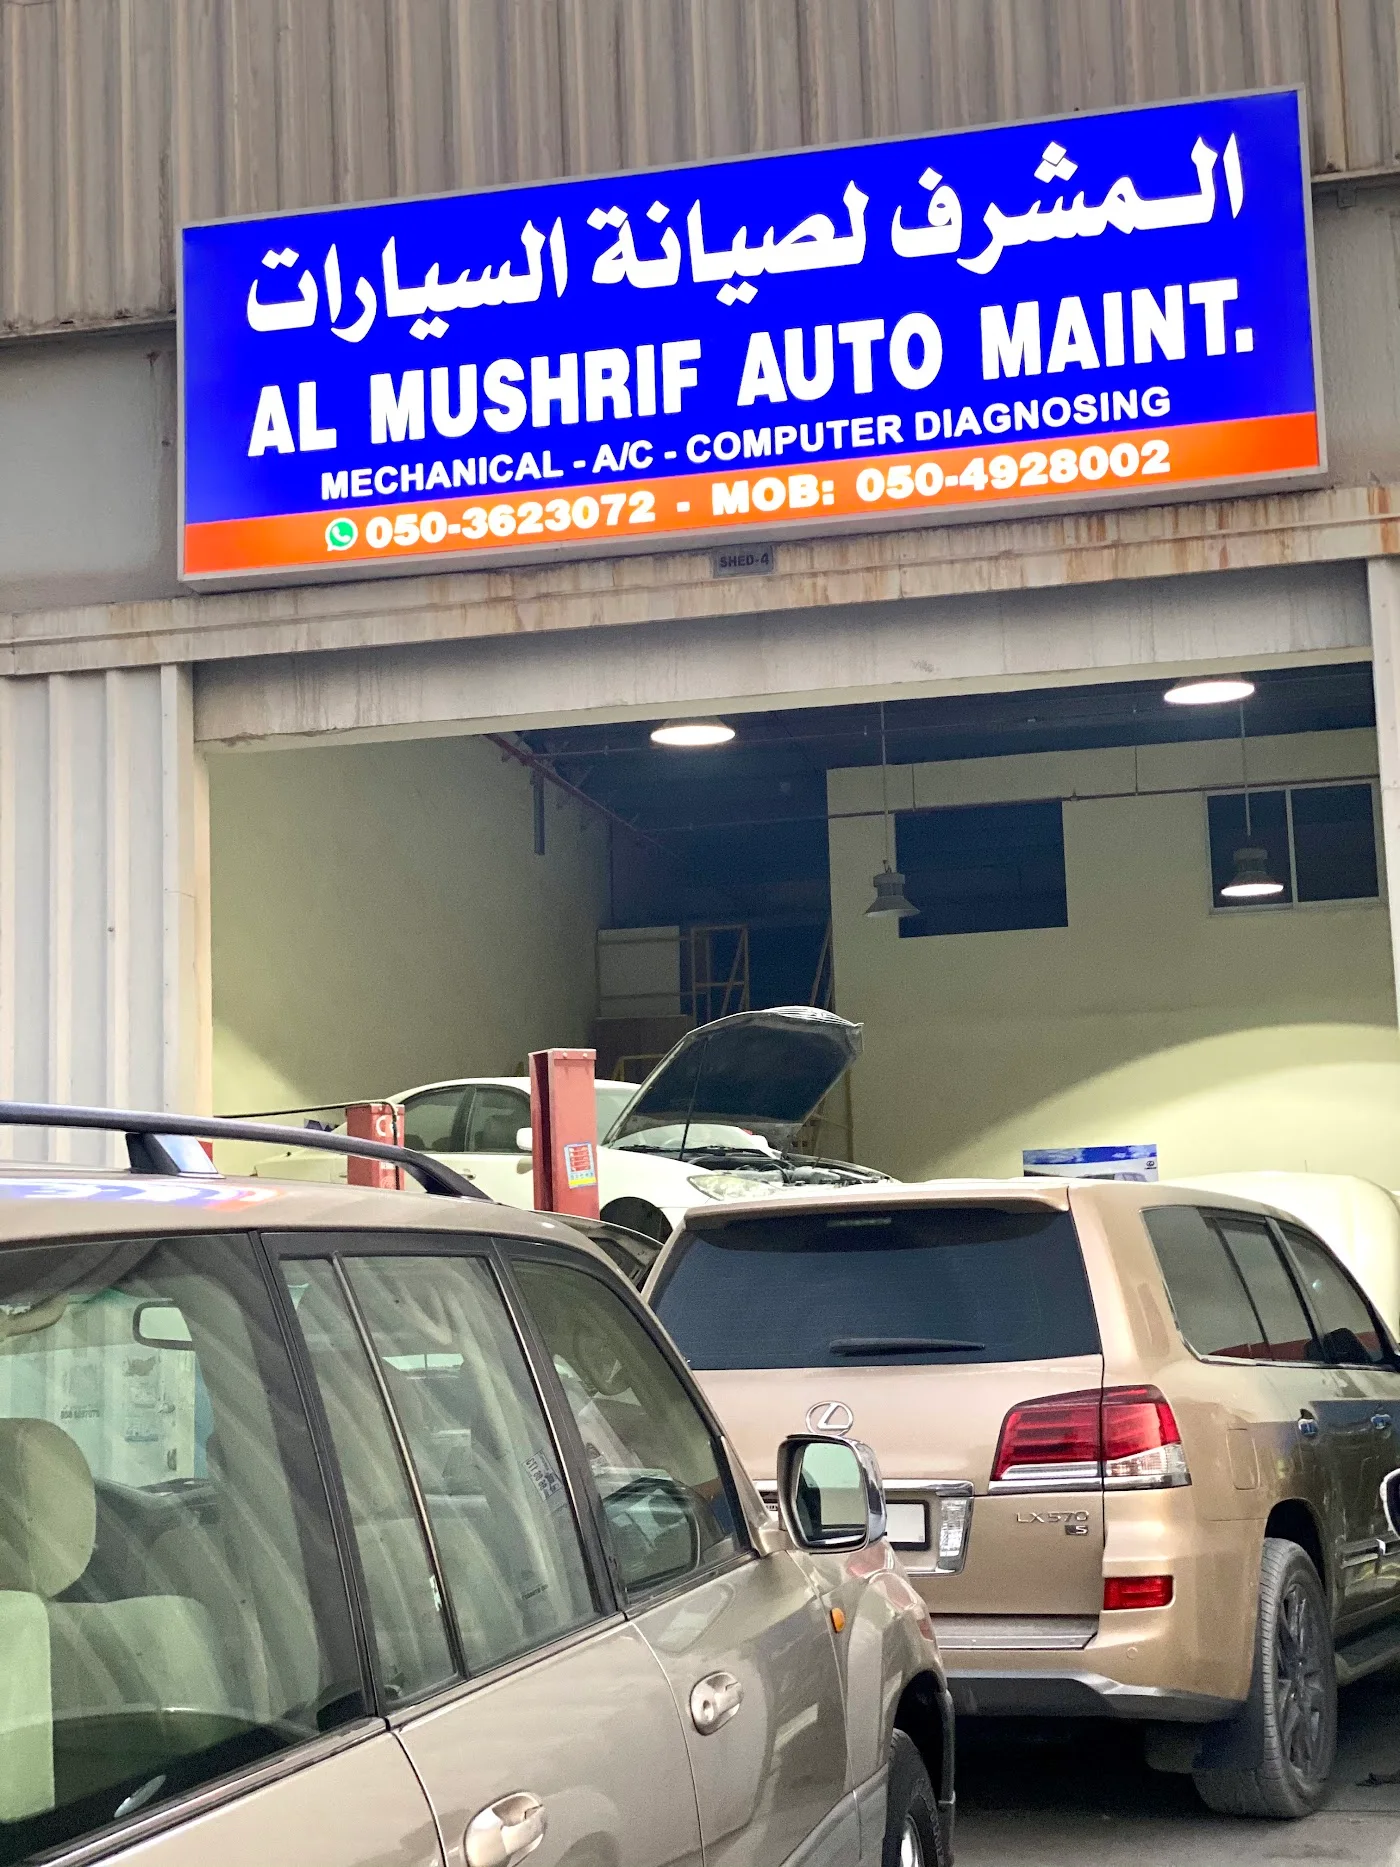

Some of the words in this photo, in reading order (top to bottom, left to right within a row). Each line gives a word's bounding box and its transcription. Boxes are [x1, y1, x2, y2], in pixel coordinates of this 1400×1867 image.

[586, 179, 870, 306] لصيانة
[891, 132, 1244, 275] المشرف
[246, 216, 568, 343] السيارات
[247, 381, 338, 457] AL
[370, 339, 702, 445] MUSHRIF
[736, 312, 943, 407] AUTO
[980, 278, 1254, 381] MAINT.
[321, 450, 564, 501] MECHANICAL
[591, 439, 654, 474] A/C
[686, 414, 904, 464] COMPUTER
[914, 386, 1171, 441] DIAGNOSING
[365, 490, 656, 549] 050-3623072
[711, 473, 835, 516] MOB:
[855, 439, 1171, 502] 050-4928002
[719, 552, 769, 568] SHED-4
[1016, 1512, 1045, 1524] LX
[1047, 1509, 1090, 1523] 570
